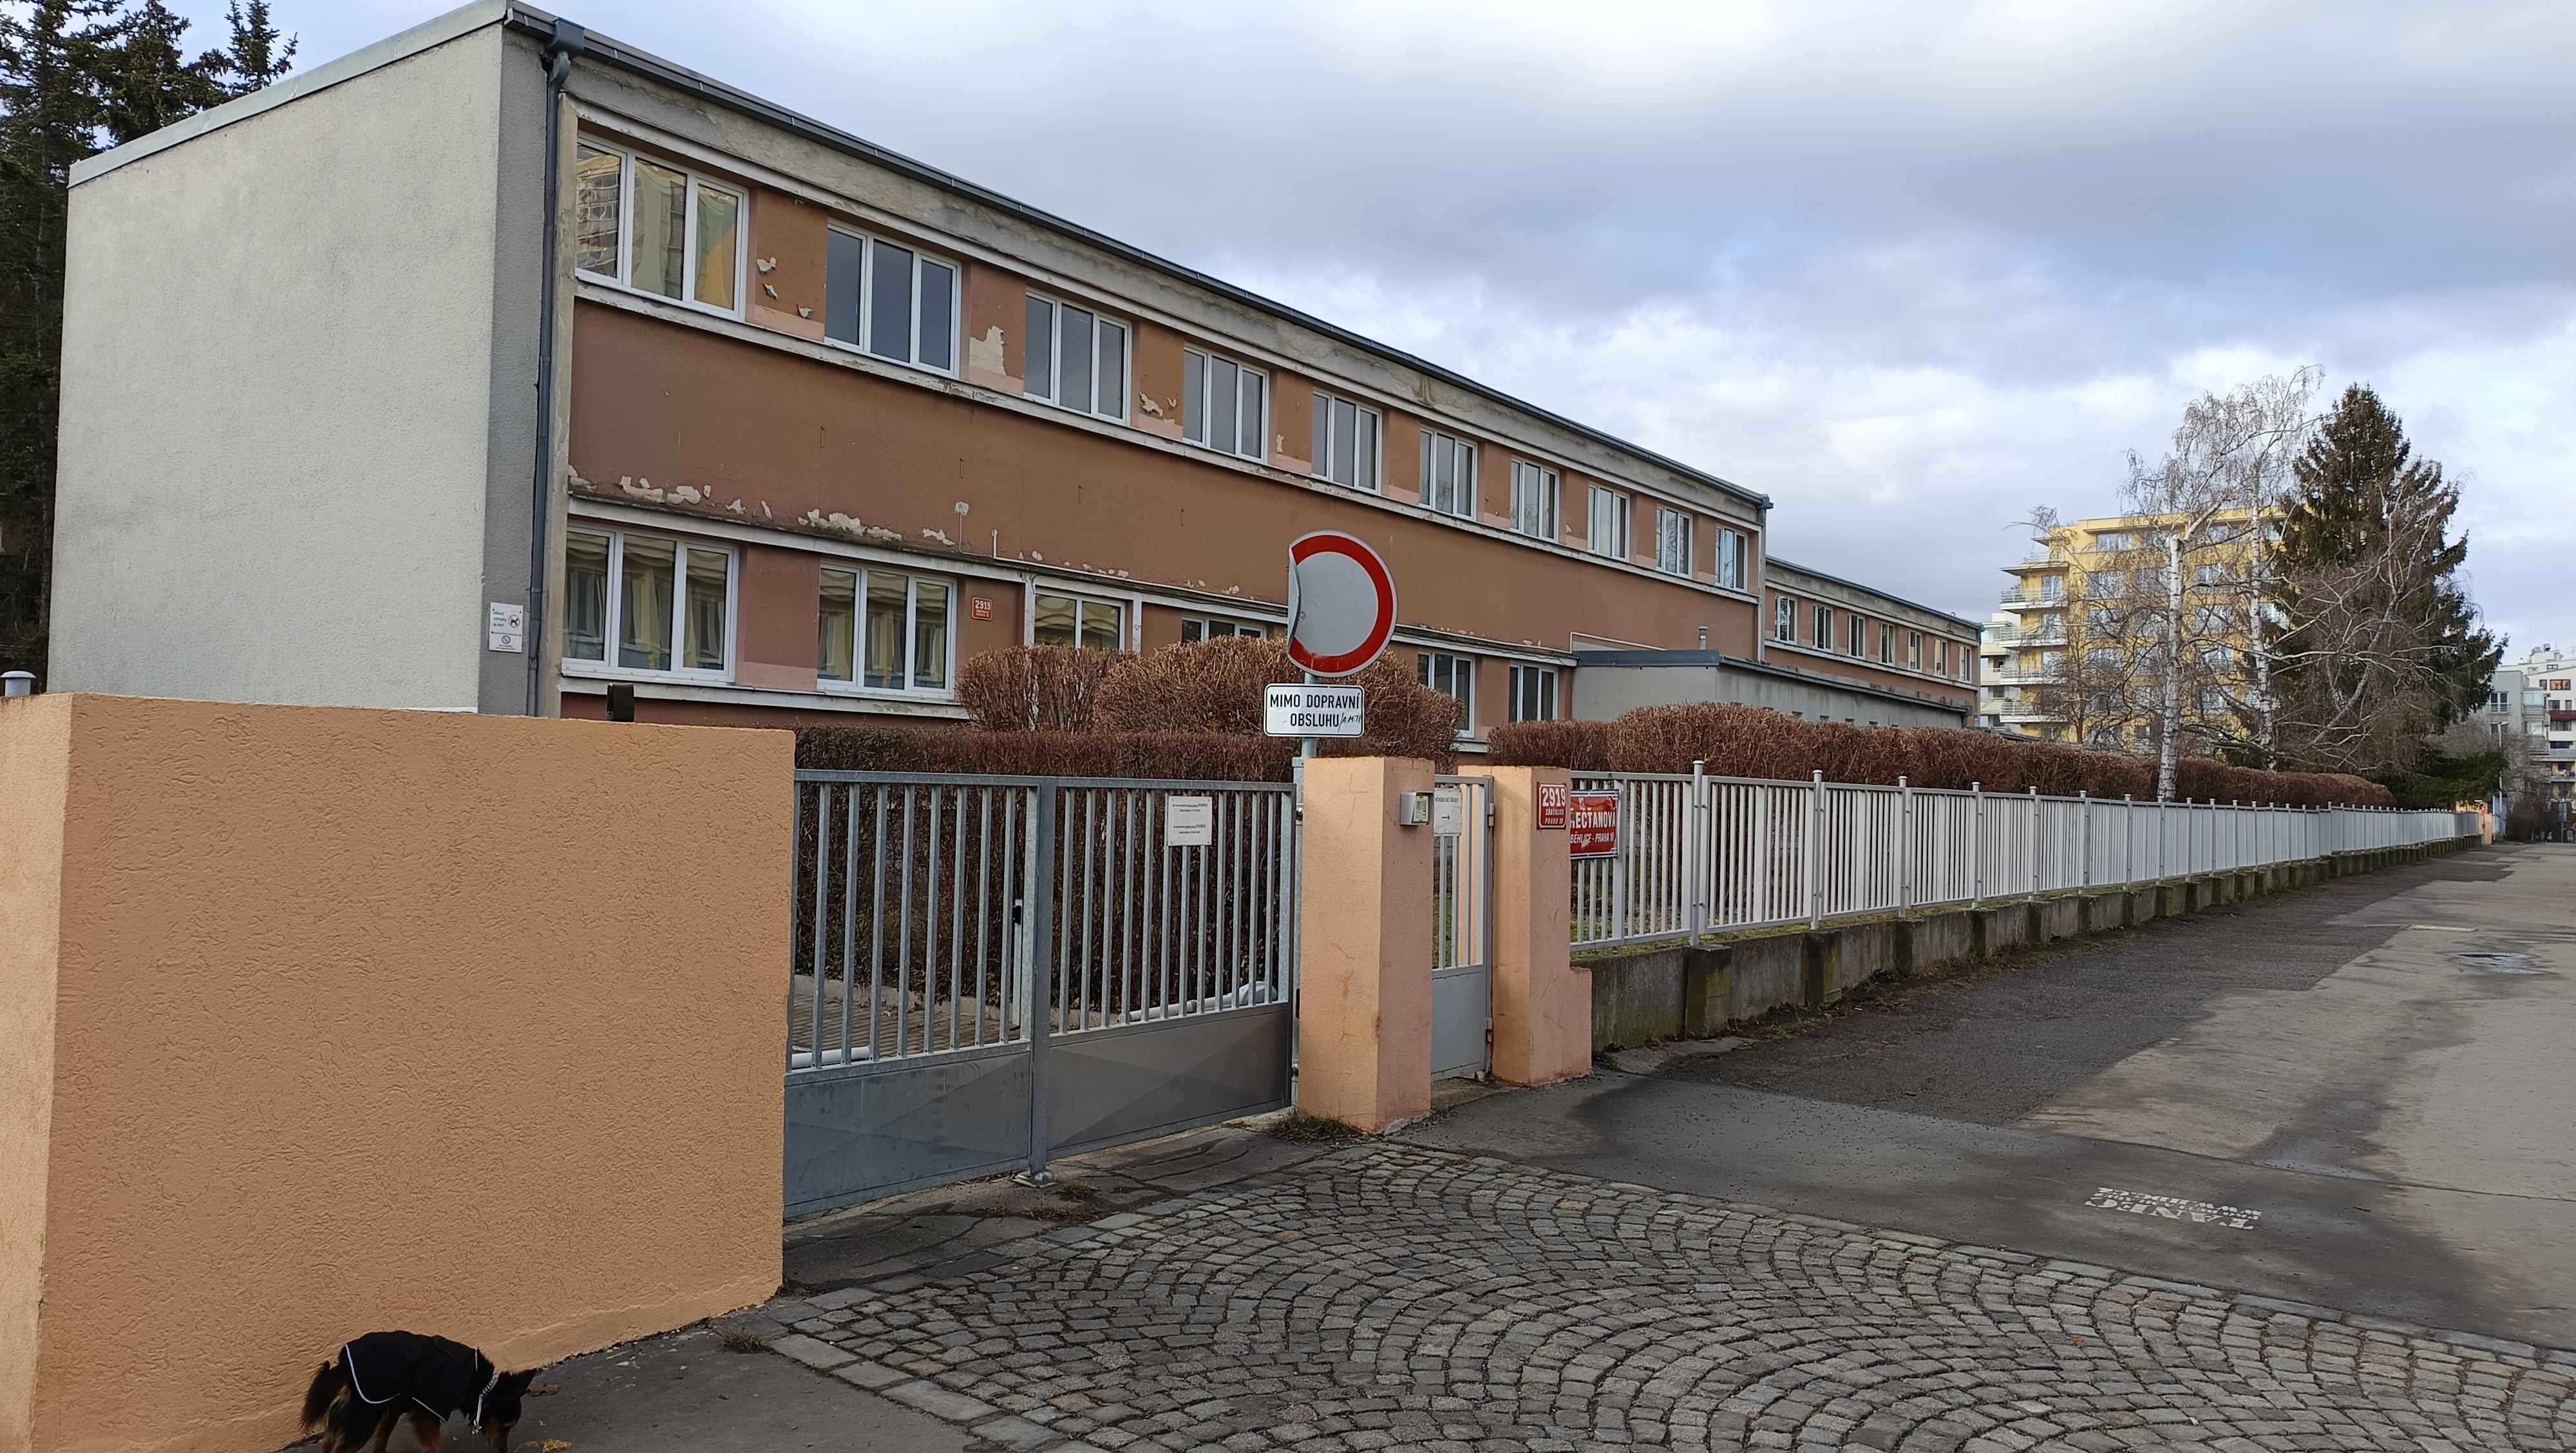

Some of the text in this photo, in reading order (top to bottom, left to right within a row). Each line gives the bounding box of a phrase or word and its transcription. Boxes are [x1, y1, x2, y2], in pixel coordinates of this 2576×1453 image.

[976, 600, 990, 610] 2919
[1270, 693, 1360, 708] MIMO DOPRAVNÍ
[1290, 713, 1339, 726] OBSLUHU
[1542, 787, 1566, 806] 2919
[1570, 807, 1615, 828] ŘEČŤANOVÁ
[1570, 831, 1592, 844] BĚHLICE
[1595, 833, 1609, 842] PRAHA
[1610, 832, 1615, 842] 10
[2085, 1197, 2253, 1230] TANEC
